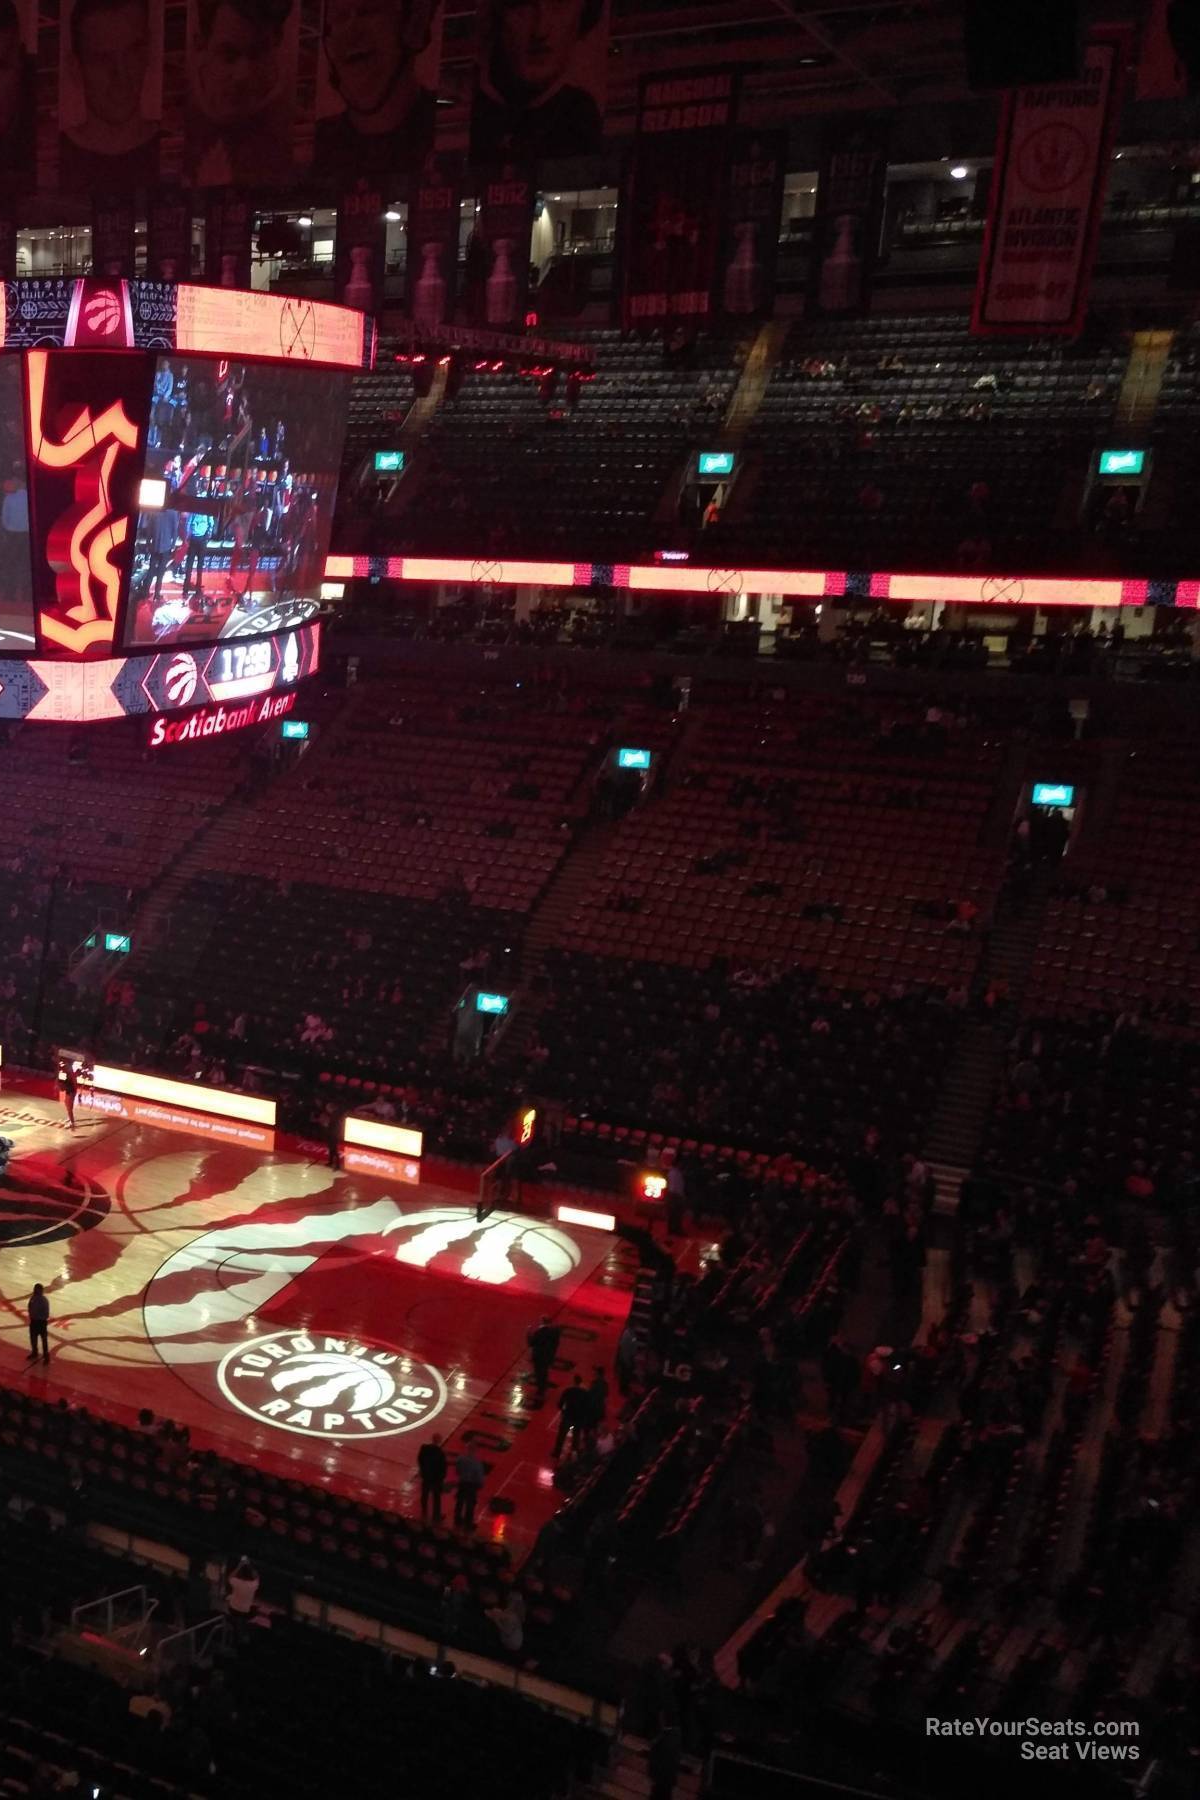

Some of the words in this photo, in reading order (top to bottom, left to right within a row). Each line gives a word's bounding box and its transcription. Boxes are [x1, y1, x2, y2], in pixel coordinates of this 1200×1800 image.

[1023, 89, 1099, 108] RAPTORS
[642, 103, 729, 132] SEASON
[1008, 207, 1080, 225] ATLANTIC
[1004, 229, 1076, 247] DIVISION
[151, 706, 255, 745] Scotiabank
[258, 692, 296, 723] Arena
[662, 1360, 692, 1382] LG
[259, 1384, 434, 1430] RAPTORS
